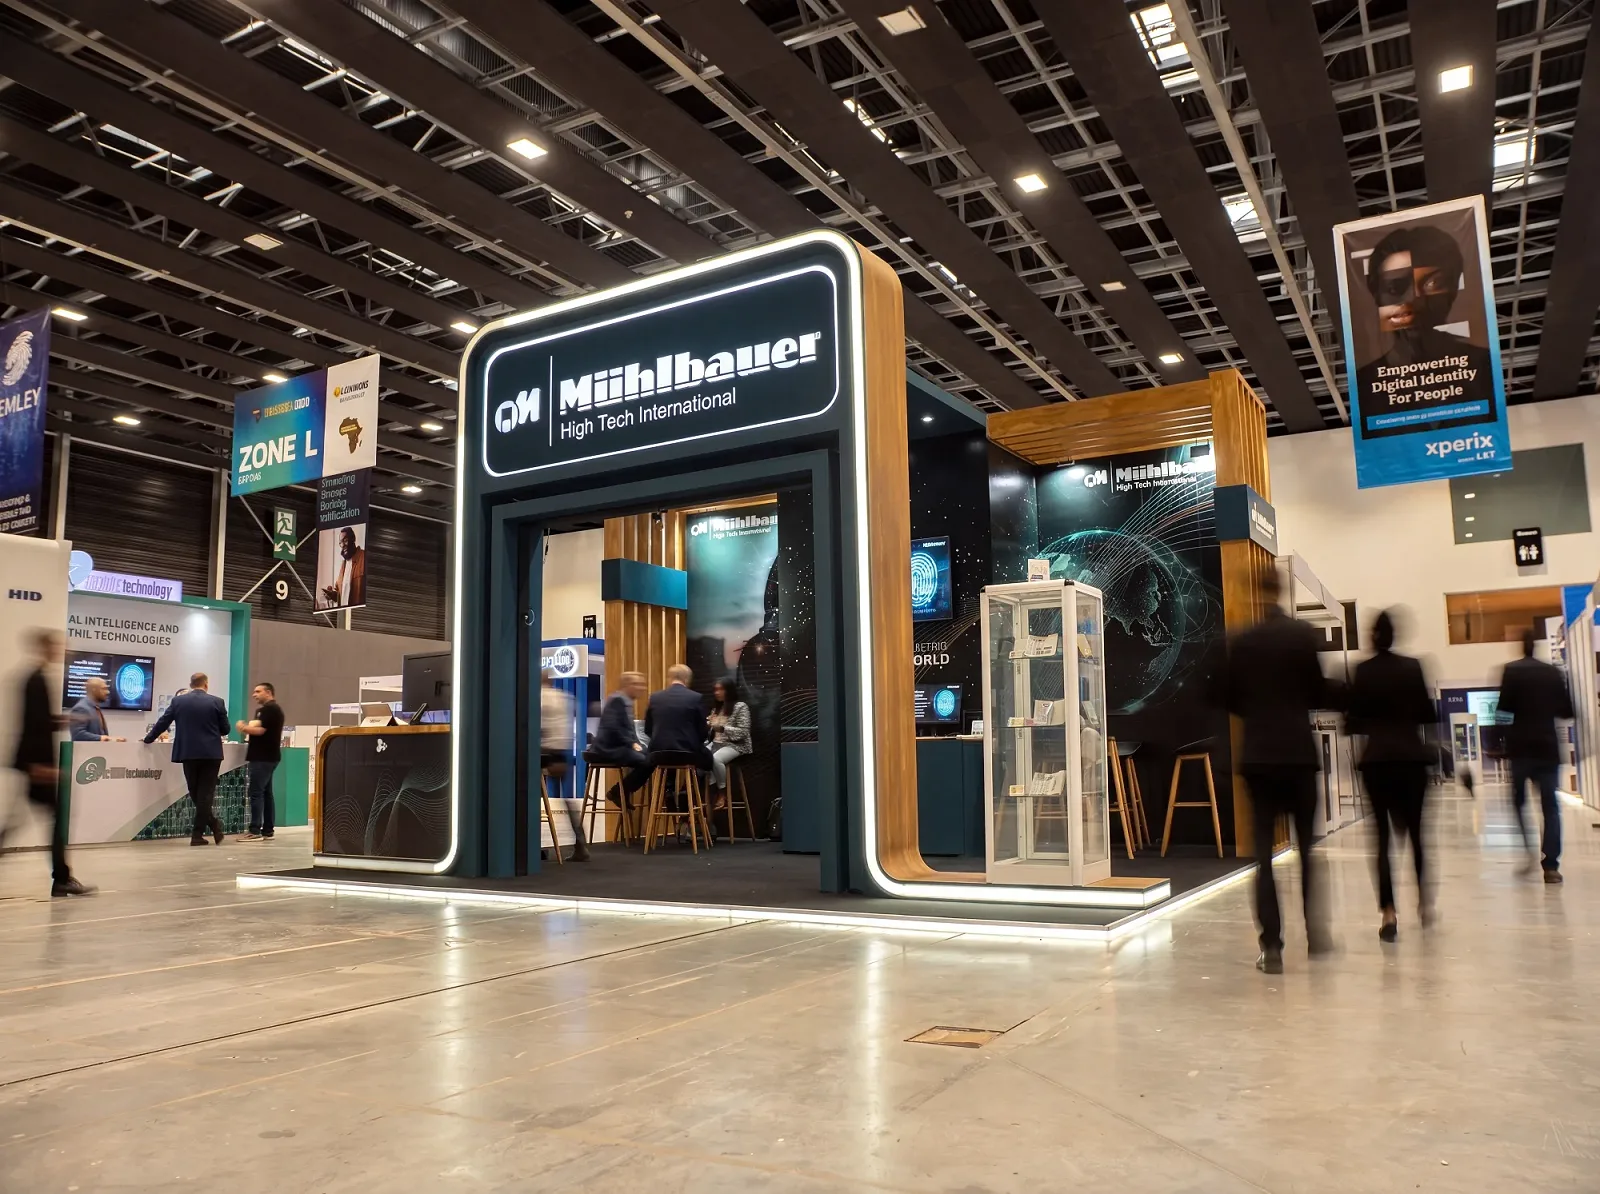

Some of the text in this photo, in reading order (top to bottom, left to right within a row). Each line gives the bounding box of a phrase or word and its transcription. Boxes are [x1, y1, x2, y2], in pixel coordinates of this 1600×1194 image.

[1377, 355, 1468, 378] Empowering
[1371, 368, 1477, 394] Digital Identity
[1388, 385, 1463, 406] For People
[560, 386, 736, 440] High Tech International
[238, 430, 318, 473] ZONE L
[1425, 431, 1493, 458] xperix
[8, 588, 43, 602] HID
[122, 578, 173, 601] technology
[275, 579, 289, 601] 9
[84, 616, 157, 632] INTELLIGENCE
[158, 624, 180, 634] AND
[94, 630, 172, 646] TECHNOLOGIES
